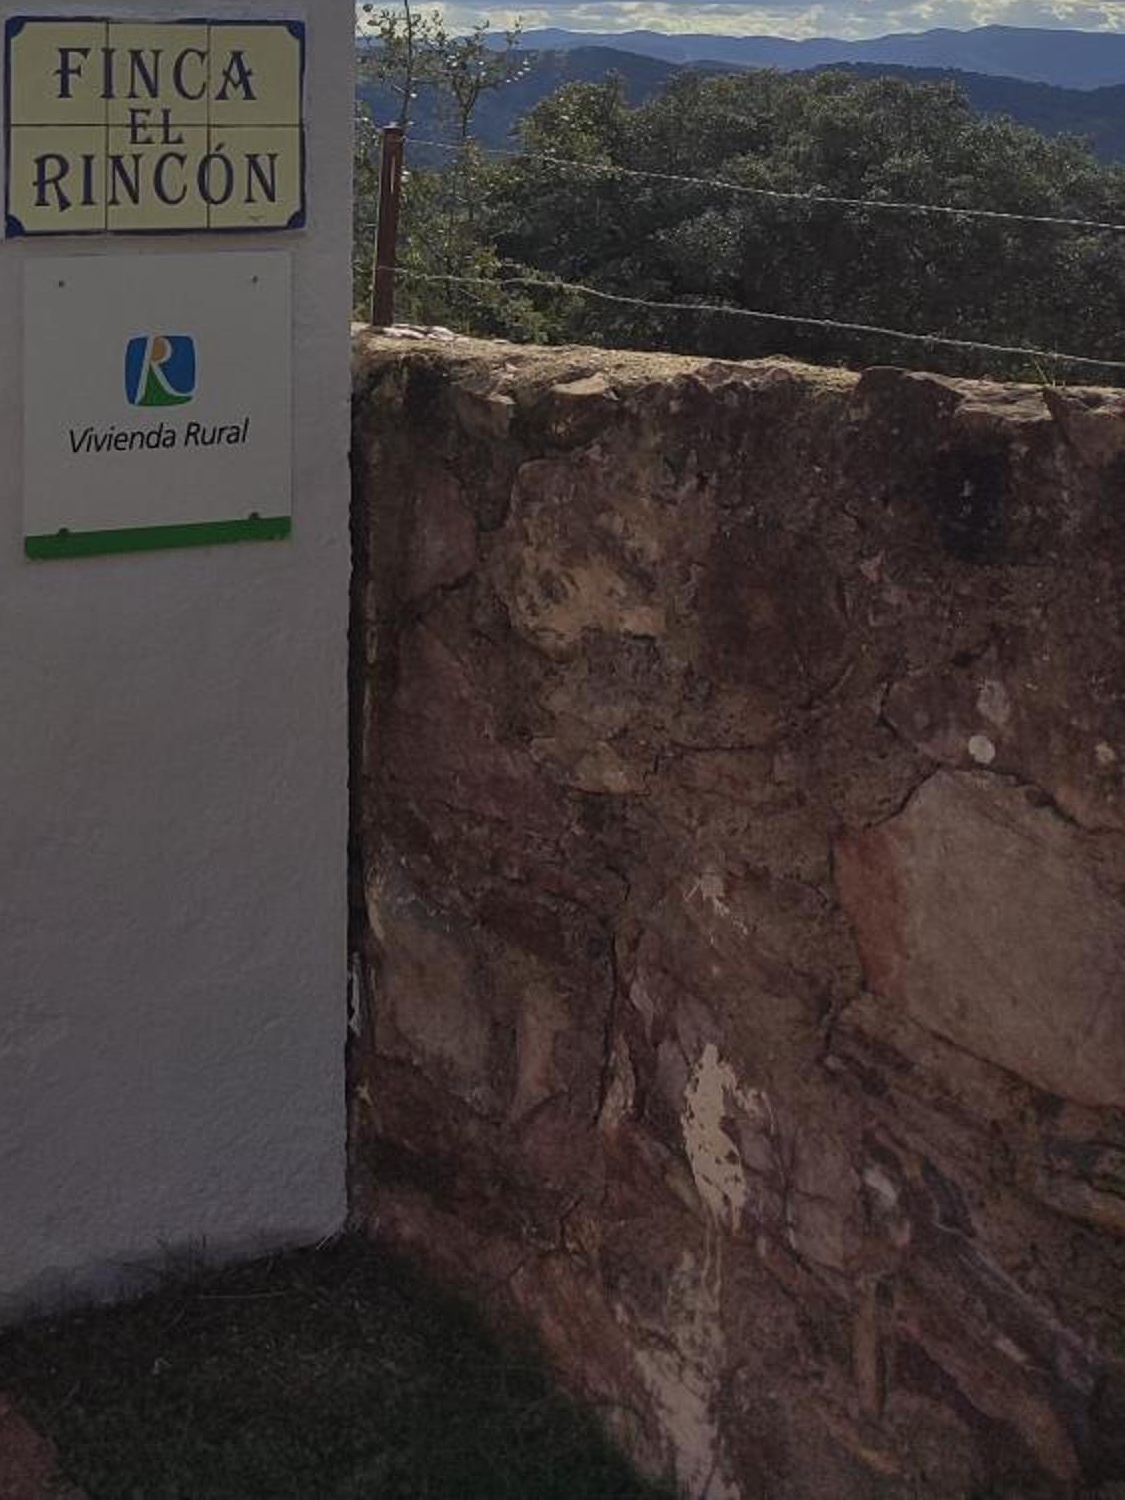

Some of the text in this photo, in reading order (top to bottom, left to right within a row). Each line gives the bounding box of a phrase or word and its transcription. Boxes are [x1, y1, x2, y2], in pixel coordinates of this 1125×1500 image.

[53, 47, 257, 100] FINCA
[128, 107, 184, 145] EL
[32, 142, 279, 212] RINCÓN
[68, 416, 251, 453] Vivienda Rural
